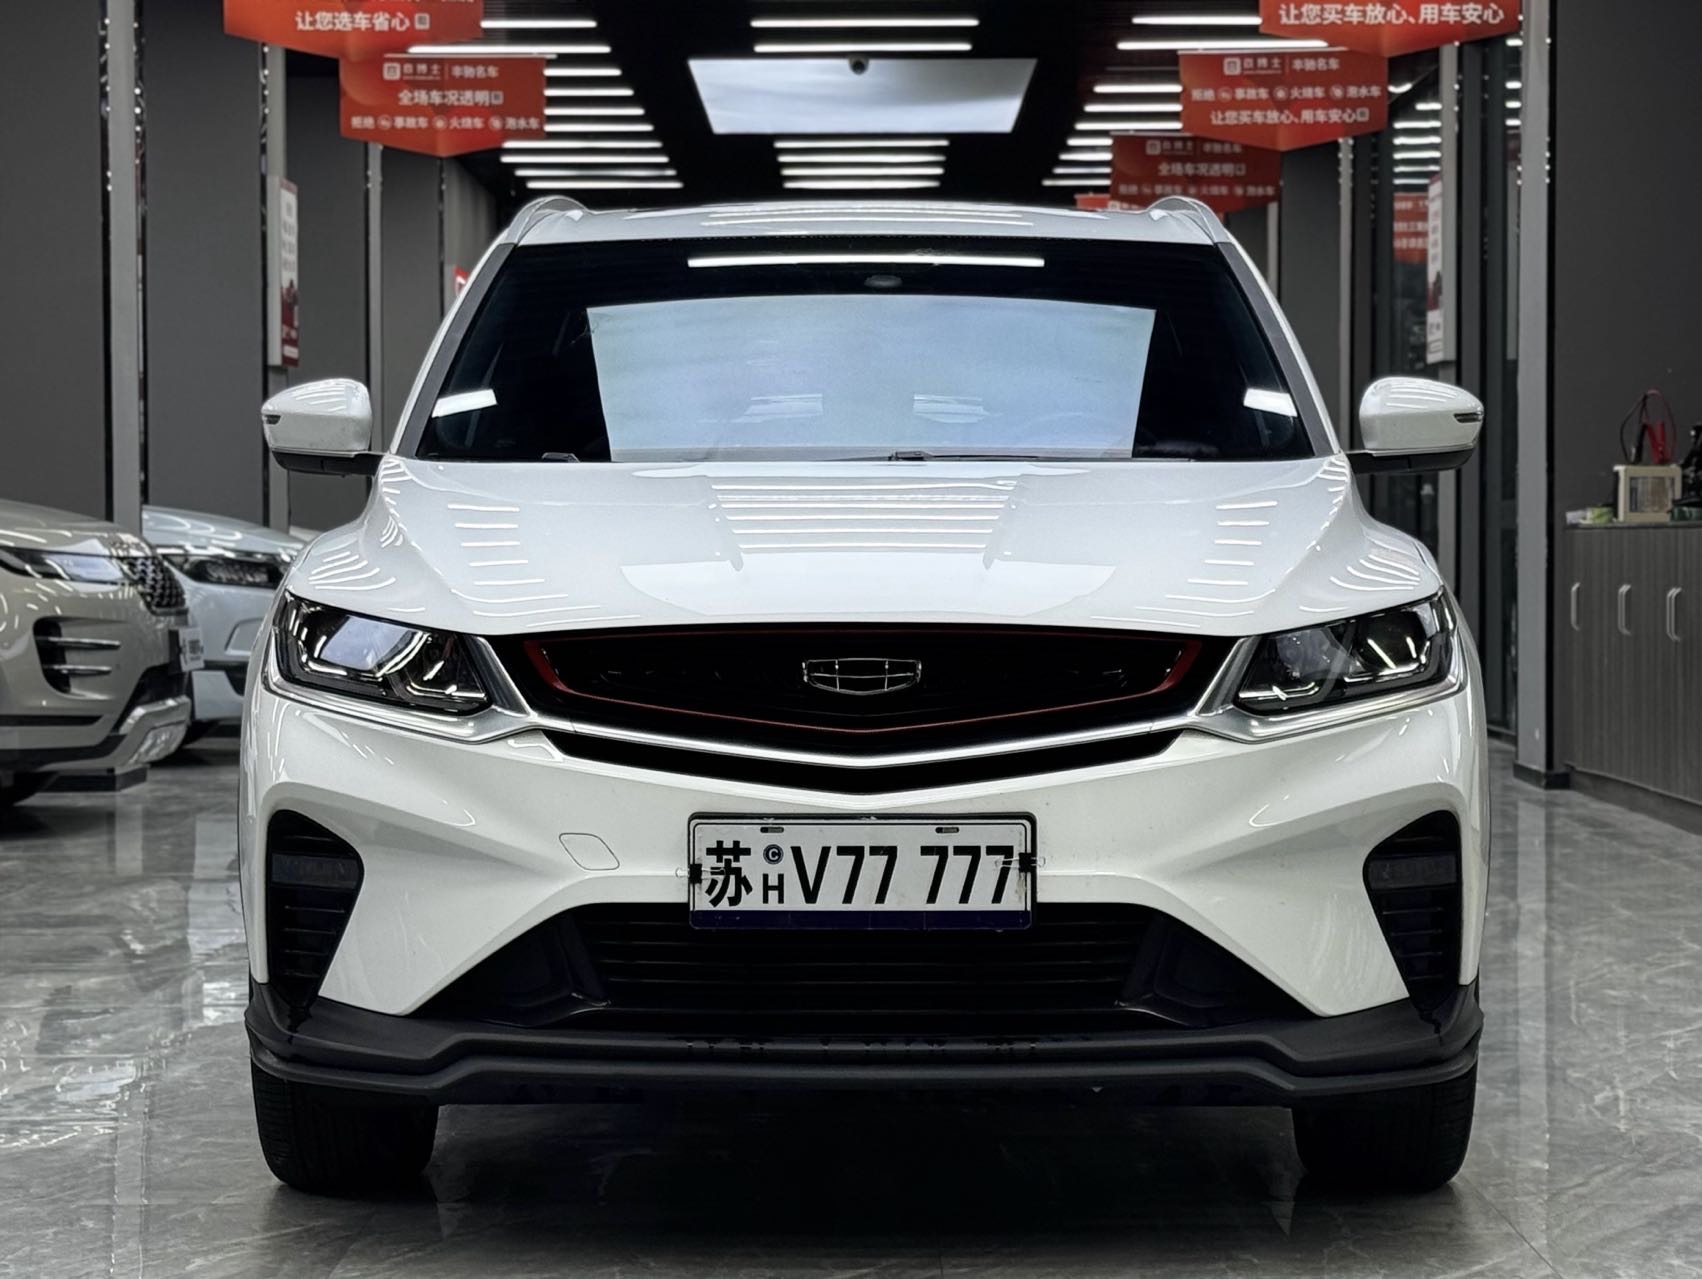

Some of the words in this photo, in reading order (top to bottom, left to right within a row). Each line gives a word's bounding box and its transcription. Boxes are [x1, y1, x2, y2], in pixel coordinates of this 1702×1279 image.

[295, 11, 410, 31] 让您选车省心
[1278, 2, 1504, 25] 让您买车放心、用车安心
[398, 90, 492, 106] 全场车况透明
[1210, 108, 1356, 125] 让您买车放心、用车安心
[705, 840, 752, 907] 苏
[762, 873, 785, 904] H
[790, 845, 898, 904] V77
[920, 845, 1014, 904] 777
